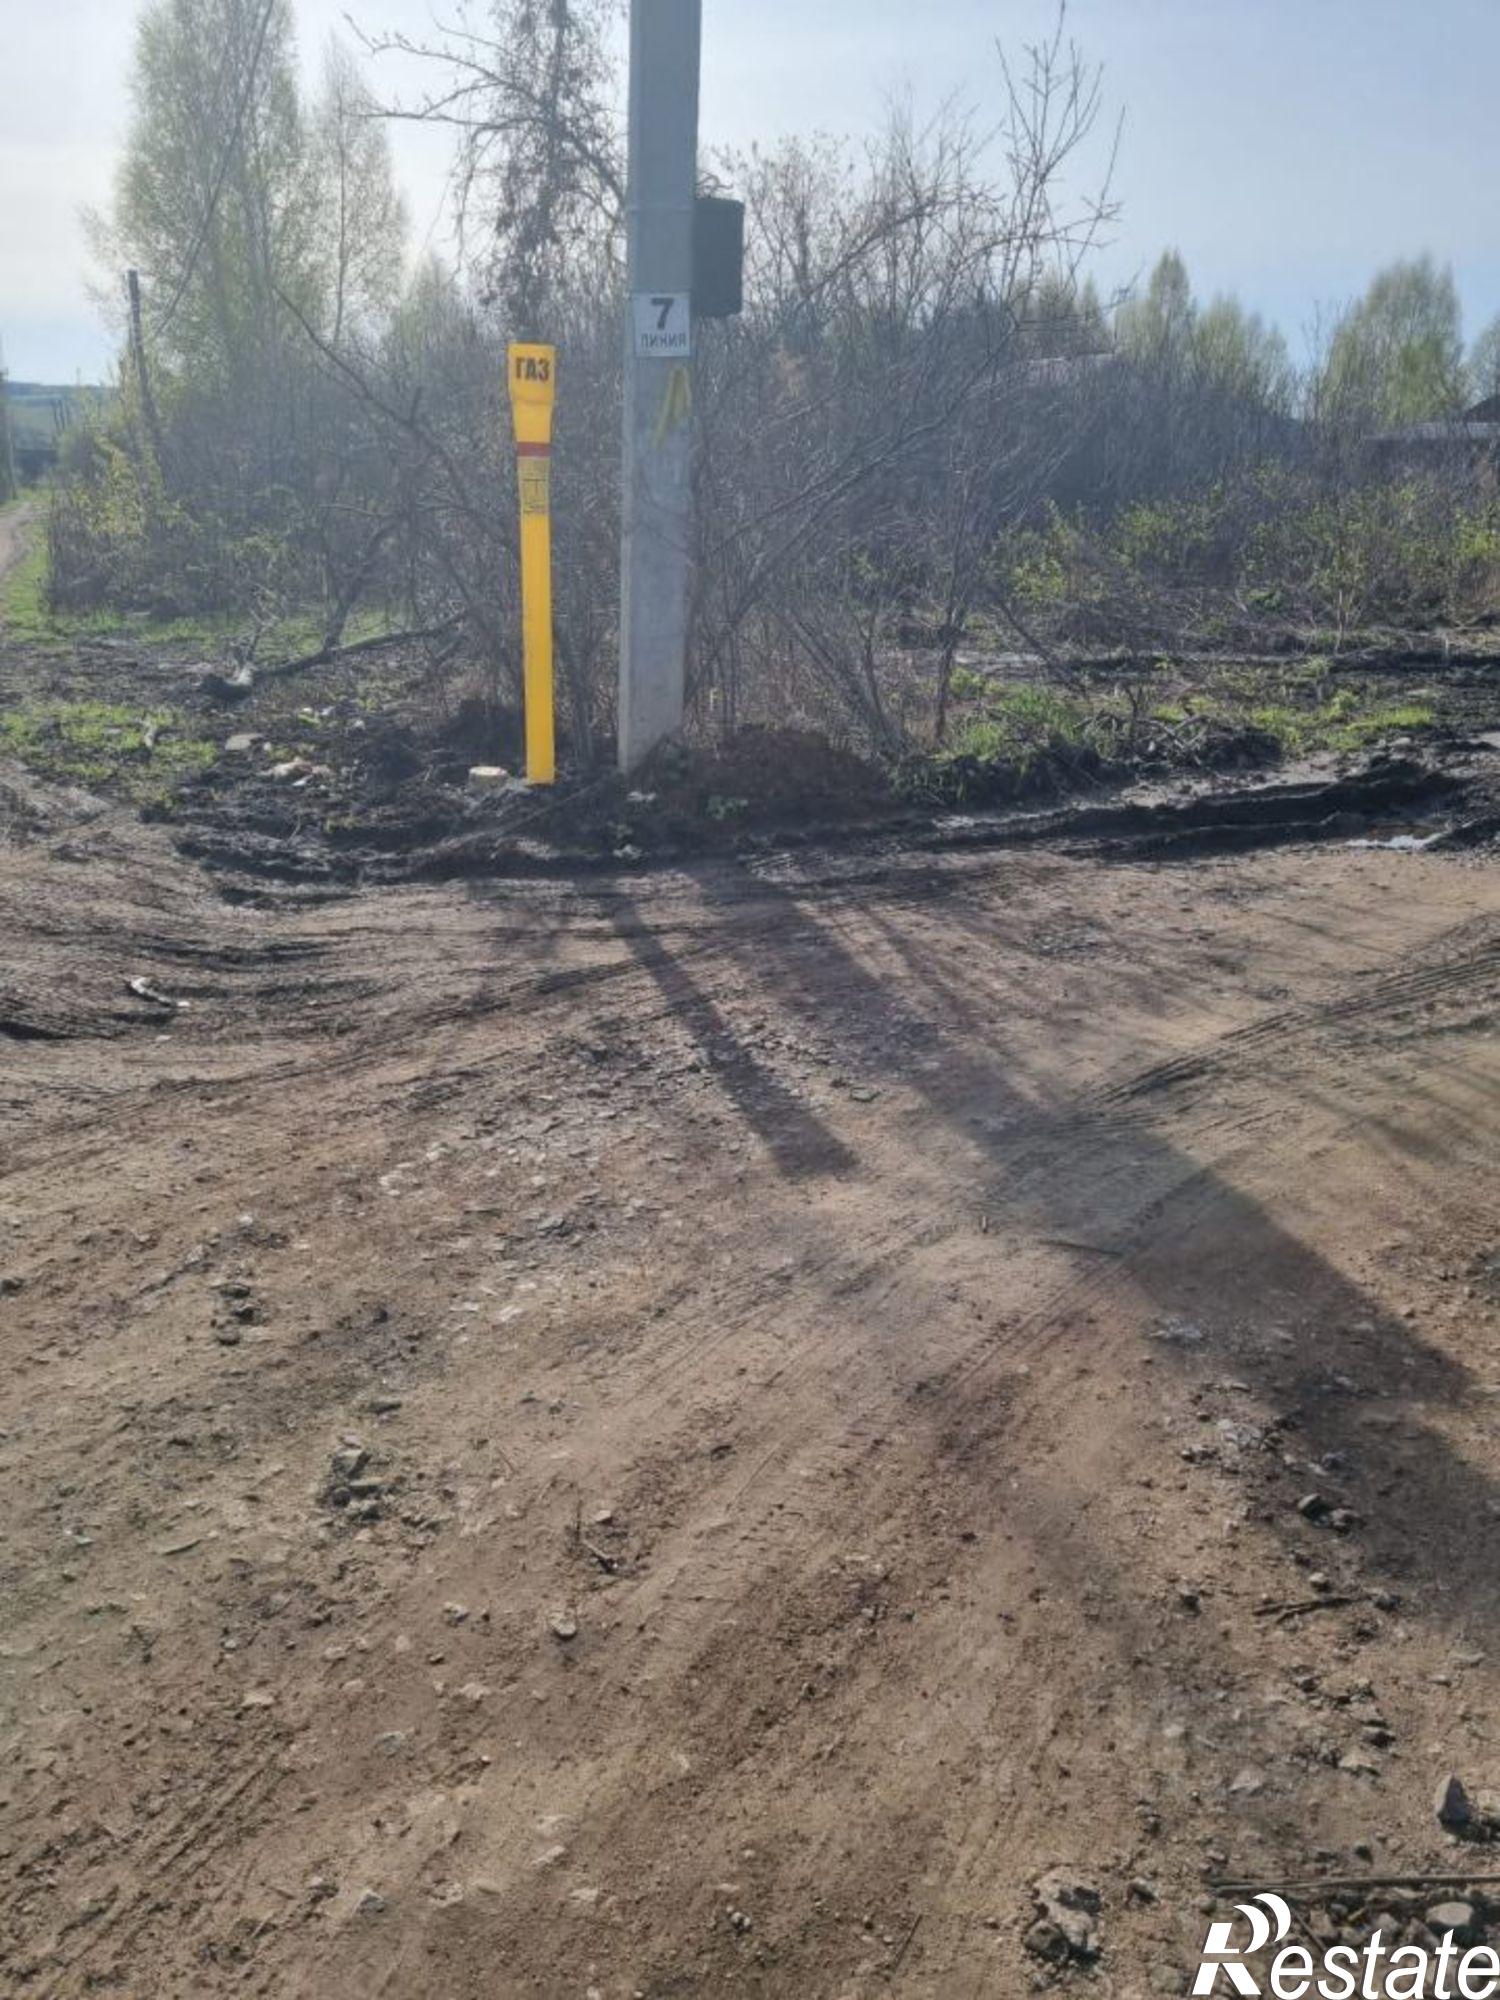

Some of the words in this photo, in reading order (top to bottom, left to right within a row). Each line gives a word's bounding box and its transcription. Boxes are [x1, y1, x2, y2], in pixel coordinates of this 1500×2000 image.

[650, 297, 675, 330] 7
[641, 332, 687, 348] ЛИНИЯ
[515, 356, 550, 382] ГАЗ
